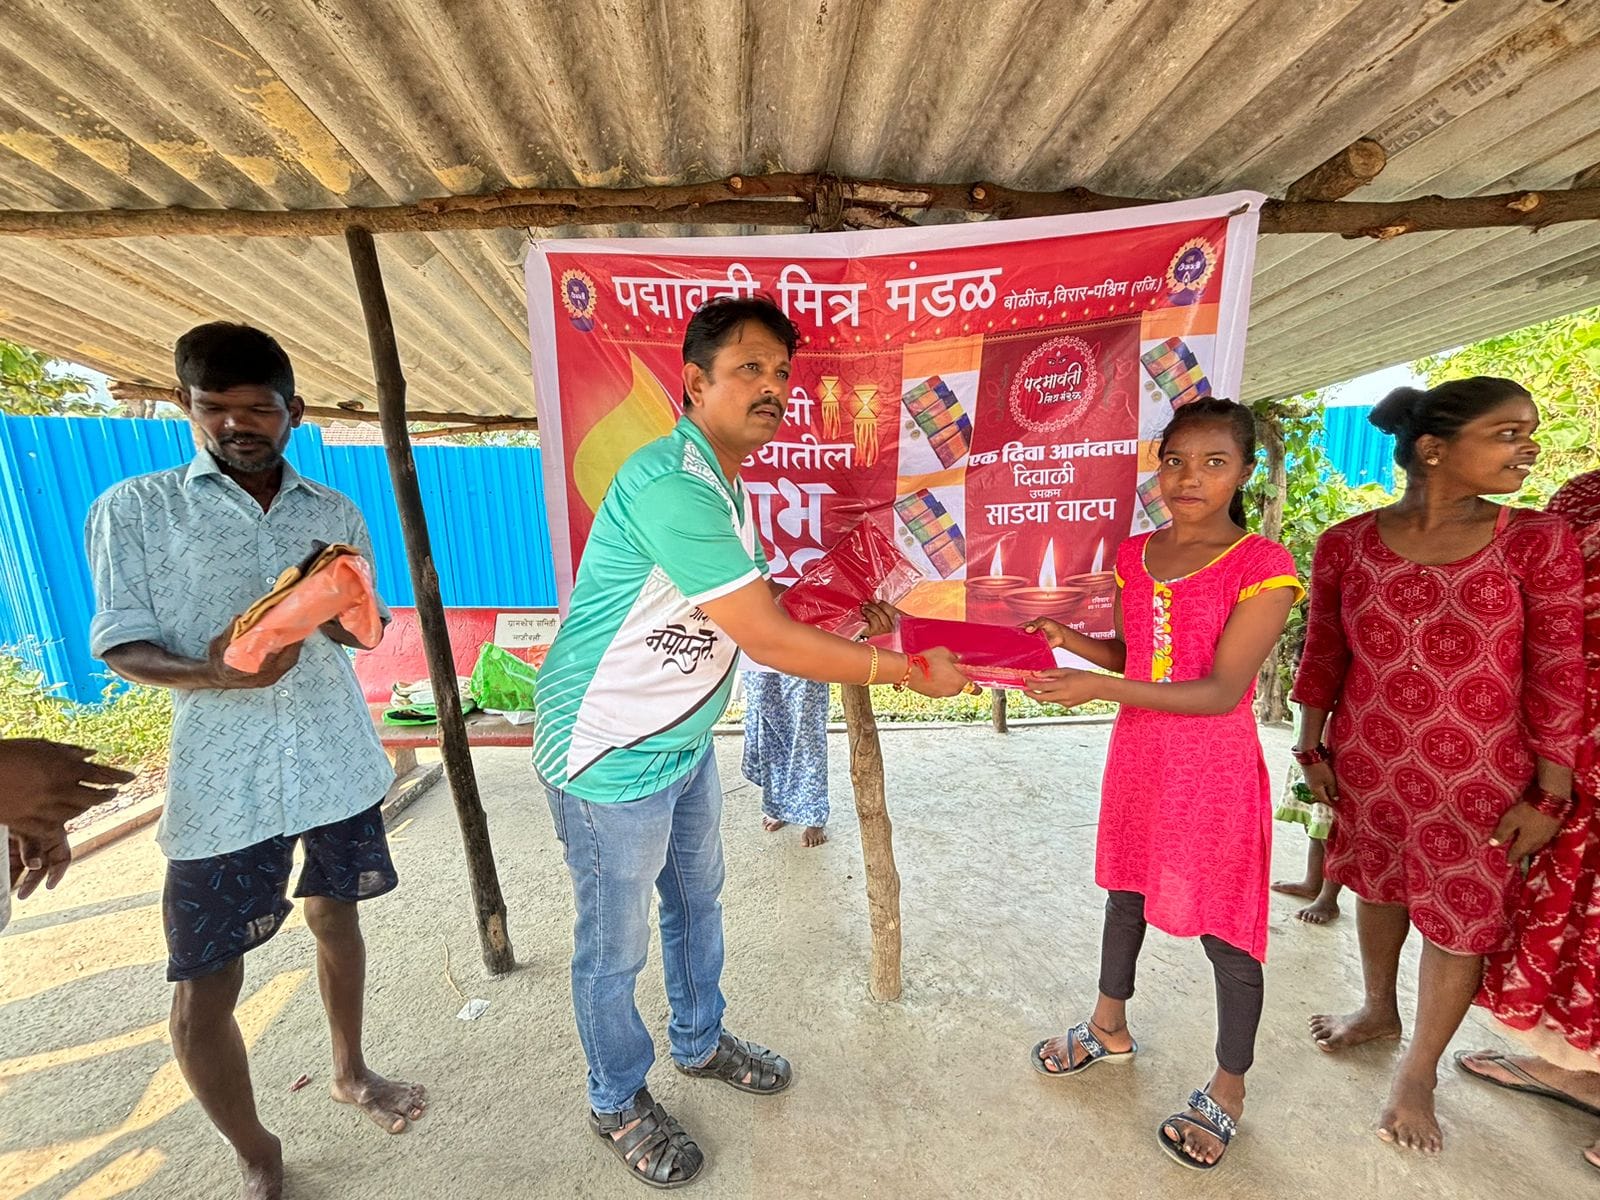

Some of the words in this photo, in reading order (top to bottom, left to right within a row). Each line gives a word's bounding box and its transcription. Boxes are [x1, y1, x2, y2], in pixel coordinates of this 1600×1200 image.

[776, 264, 867, 327] मित्र
[885, 261, 1003, 321] मंडळ
[968, 450, 1000, 467] एक
[1002, 441, 1045, 463] दिवा
[1049, 438, 1138, 460] आनंदाचा
[1013, 461, 1076, 487] दिवाळी
[1029, 488, 1062, 499] उपक्रम
[1055, 498, 1117, 522] वाटप
